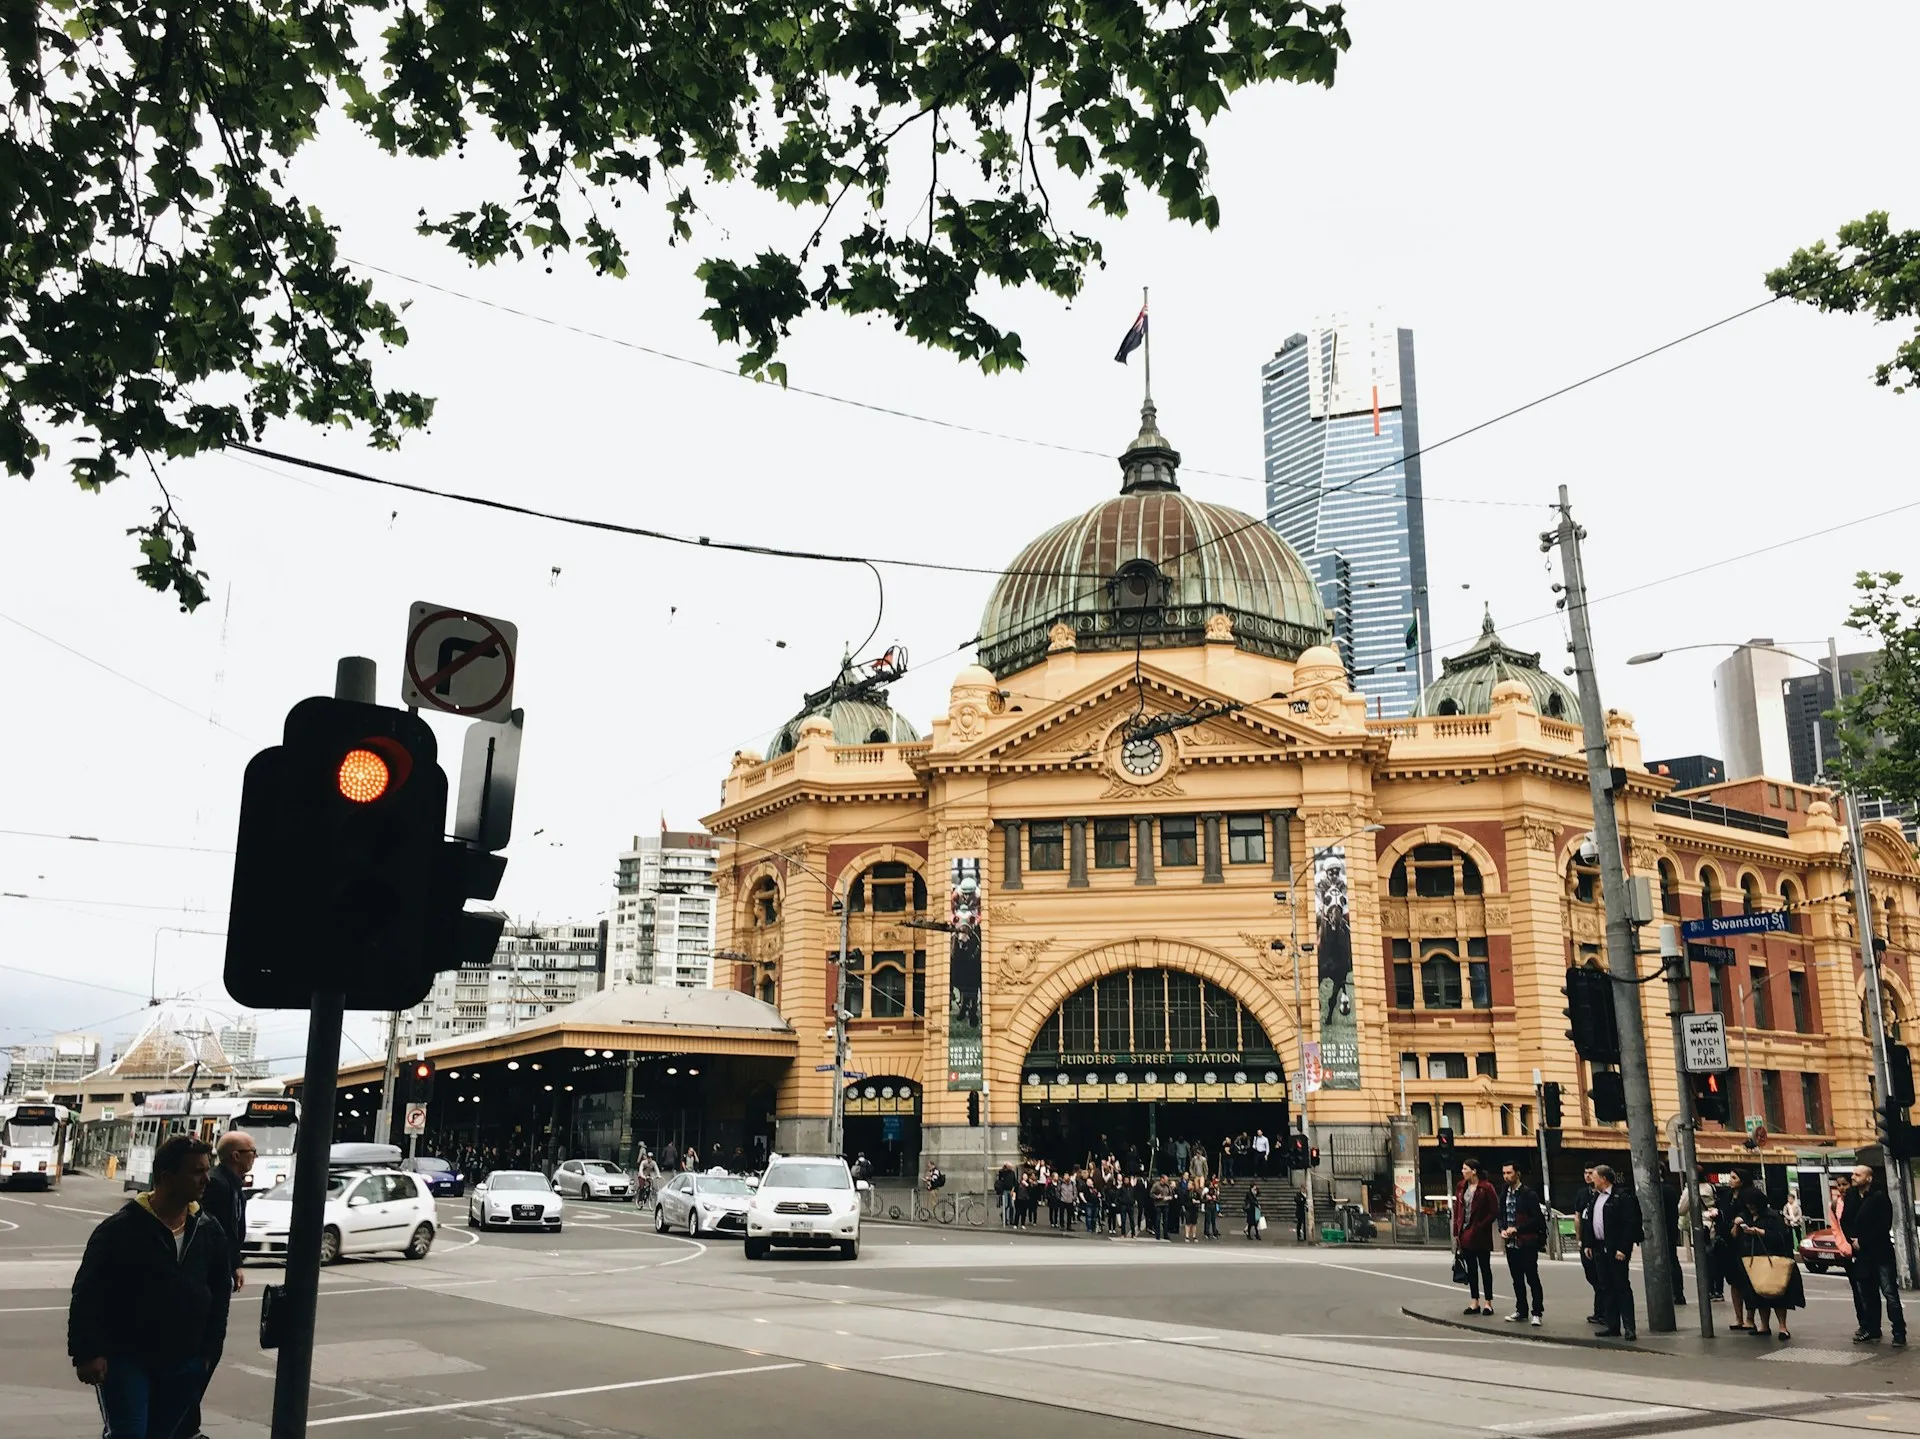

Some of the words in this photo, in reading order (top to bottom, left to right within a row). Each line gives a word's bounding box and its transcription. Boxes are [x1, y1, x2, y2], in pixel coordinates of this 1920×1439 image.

[1712, 916, 1769, 931] Swanston
[1771, 912, 1785, 925] St
[1703, 946, 1727, 960] Flinders
[1690, 1038, 1720, 1047] WATCH
[1697, 1048, 1715, 1056] FOR
[1060, 1054, 1117, 1065] FLINDERS
[1130, 1054, 1174, 1064] STREET
[1187, 1053, 1241, 1064] STATION
[1692, 1057, 1722, 1066] TRAMS
[277, 1147, 291, 1155] 210
